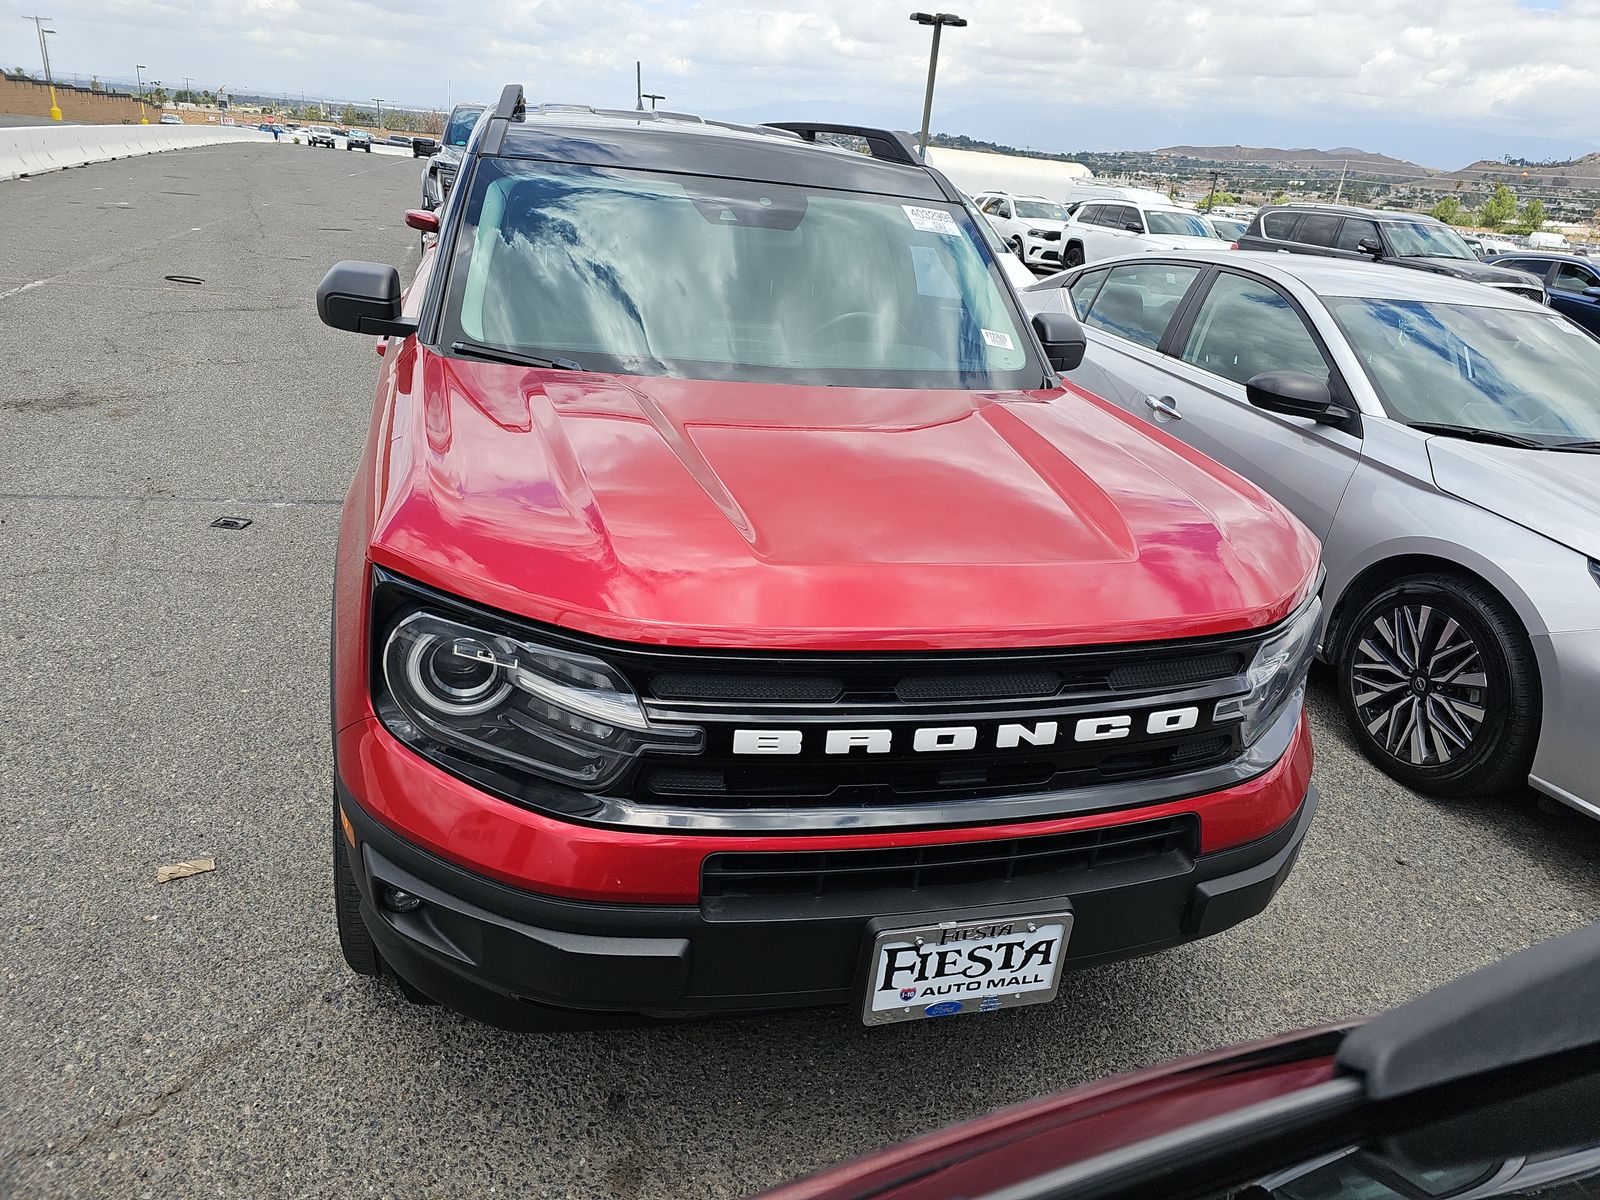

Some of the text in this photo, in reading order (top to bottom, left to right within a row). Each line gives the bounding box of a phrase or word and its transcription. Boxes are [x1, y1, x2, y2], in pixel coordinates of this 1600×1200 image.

[733, 707, 1198, 754] BRONCO
[937, 924, 1014, 945] FIESTA
[878, 938, 1058, 991] FIESTA
[920, 974, 1044, 997] AUTO MALL
[932, 1004, 955, 1015] Ford
